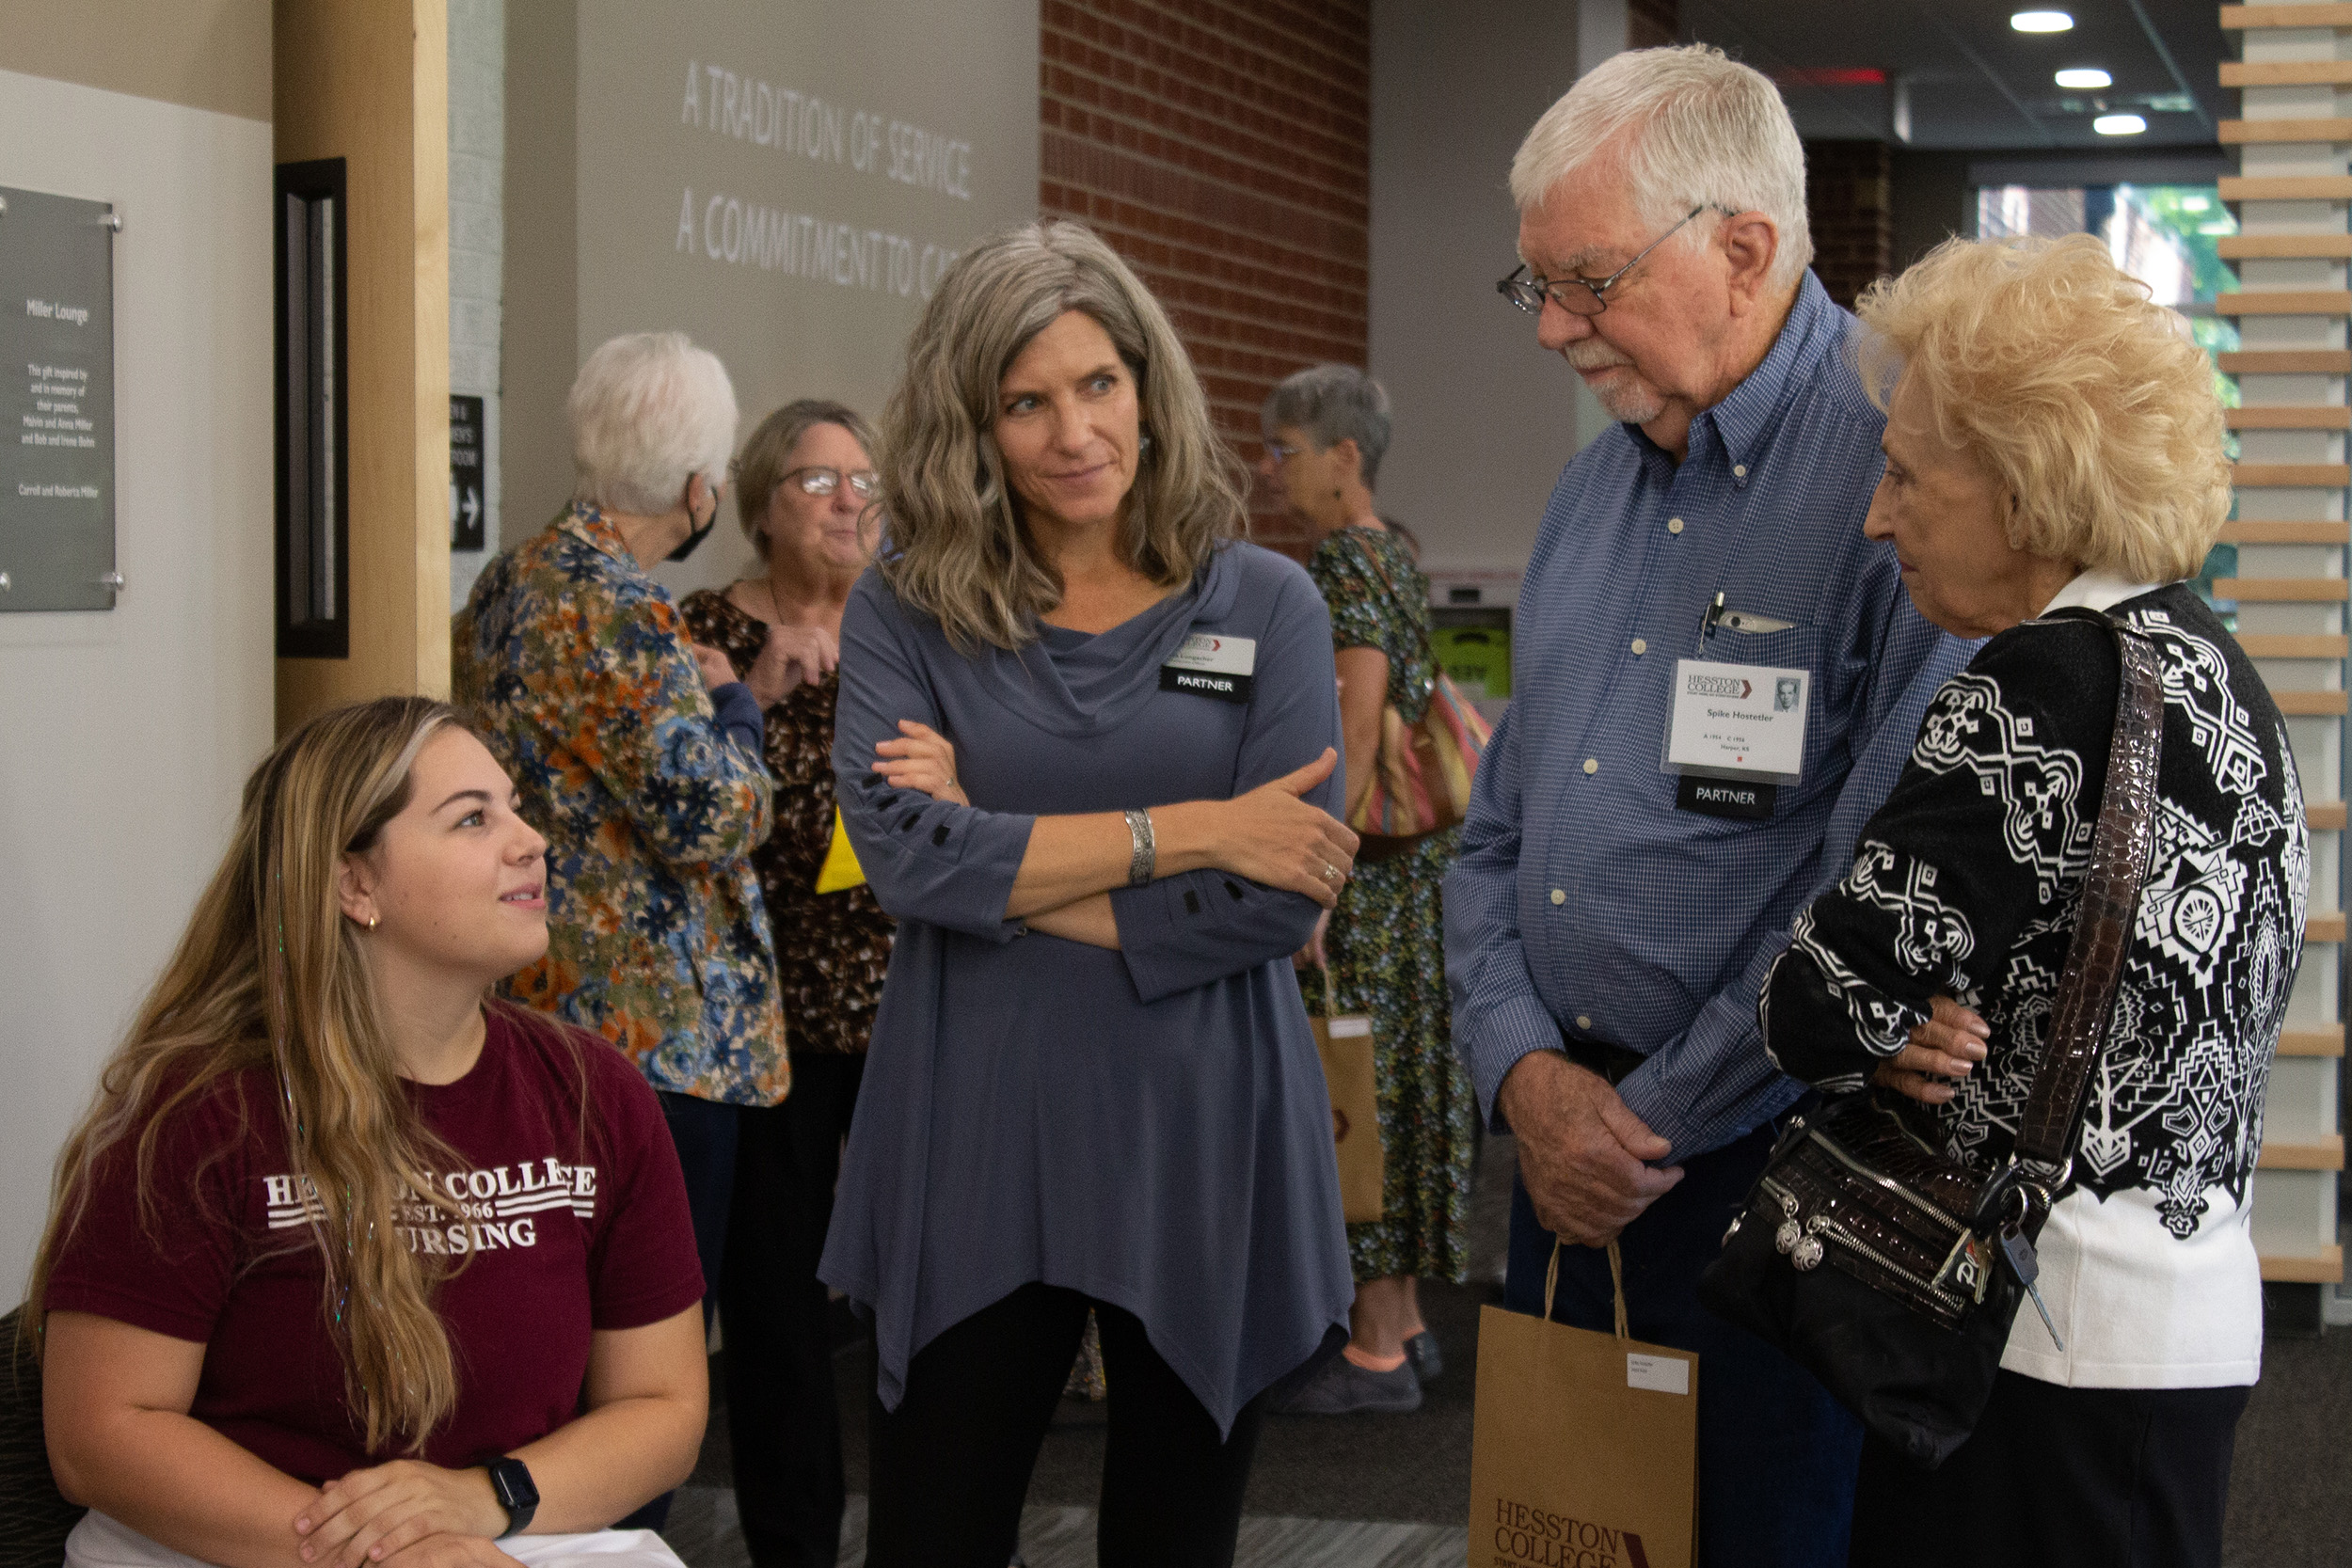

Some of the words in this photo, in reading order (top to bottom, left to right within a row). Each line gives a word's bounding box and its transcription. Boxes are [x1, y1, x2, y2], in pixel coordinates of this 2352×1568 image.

[682, 60, 700, 127] A
[707, 65, 842, 165] TRADITION
[850, 110, 882, 173] OF
[887, 119, 971, 200] SERVICE
[675, 187, 694, 254] A
[706, 194, 883, 292] COMMITMENT
[884, 233, 915, 297] TO
[26, 299, 54, 318] Miller
[56, 301, 88, 326] Lounge
[27, 364, 41, 376] This
[41, 366, 53, 381] gift
[54, 367, 79, 382] inspired
[79, 368, 88, 383] by
[30, 383, 42, 394] and
[43, 384, 50, 394] in
[50, 386, 77, 399] memory
[77, 385, 86, 397] of
[37, 399, 53, 412] their
[44, 417, 56, 429] and
[74, 418, 93, 431] Miller
[21, 433, 34, 444] and
[48, 434, 60, 446] and
[41, 485, 54, 497] and
[54, 484, 80, 498] Roberta
[1177, 675, 1233, 692] PARTNER
[1687, 682, 1740, 695] COLLEGE
[1688, 674, 1740, 688] HESSTON
[1707, 708, 1730, 720] Spike
[1732, 710, 1774, 722] Hostetler
[1695, 787, 1756, 805] PARTNER
[401, 1204, 447, 1223] EST.
[454, 1201, 495, 1221] 966
[1495, 1497, 1620, 1554] HESSTON
